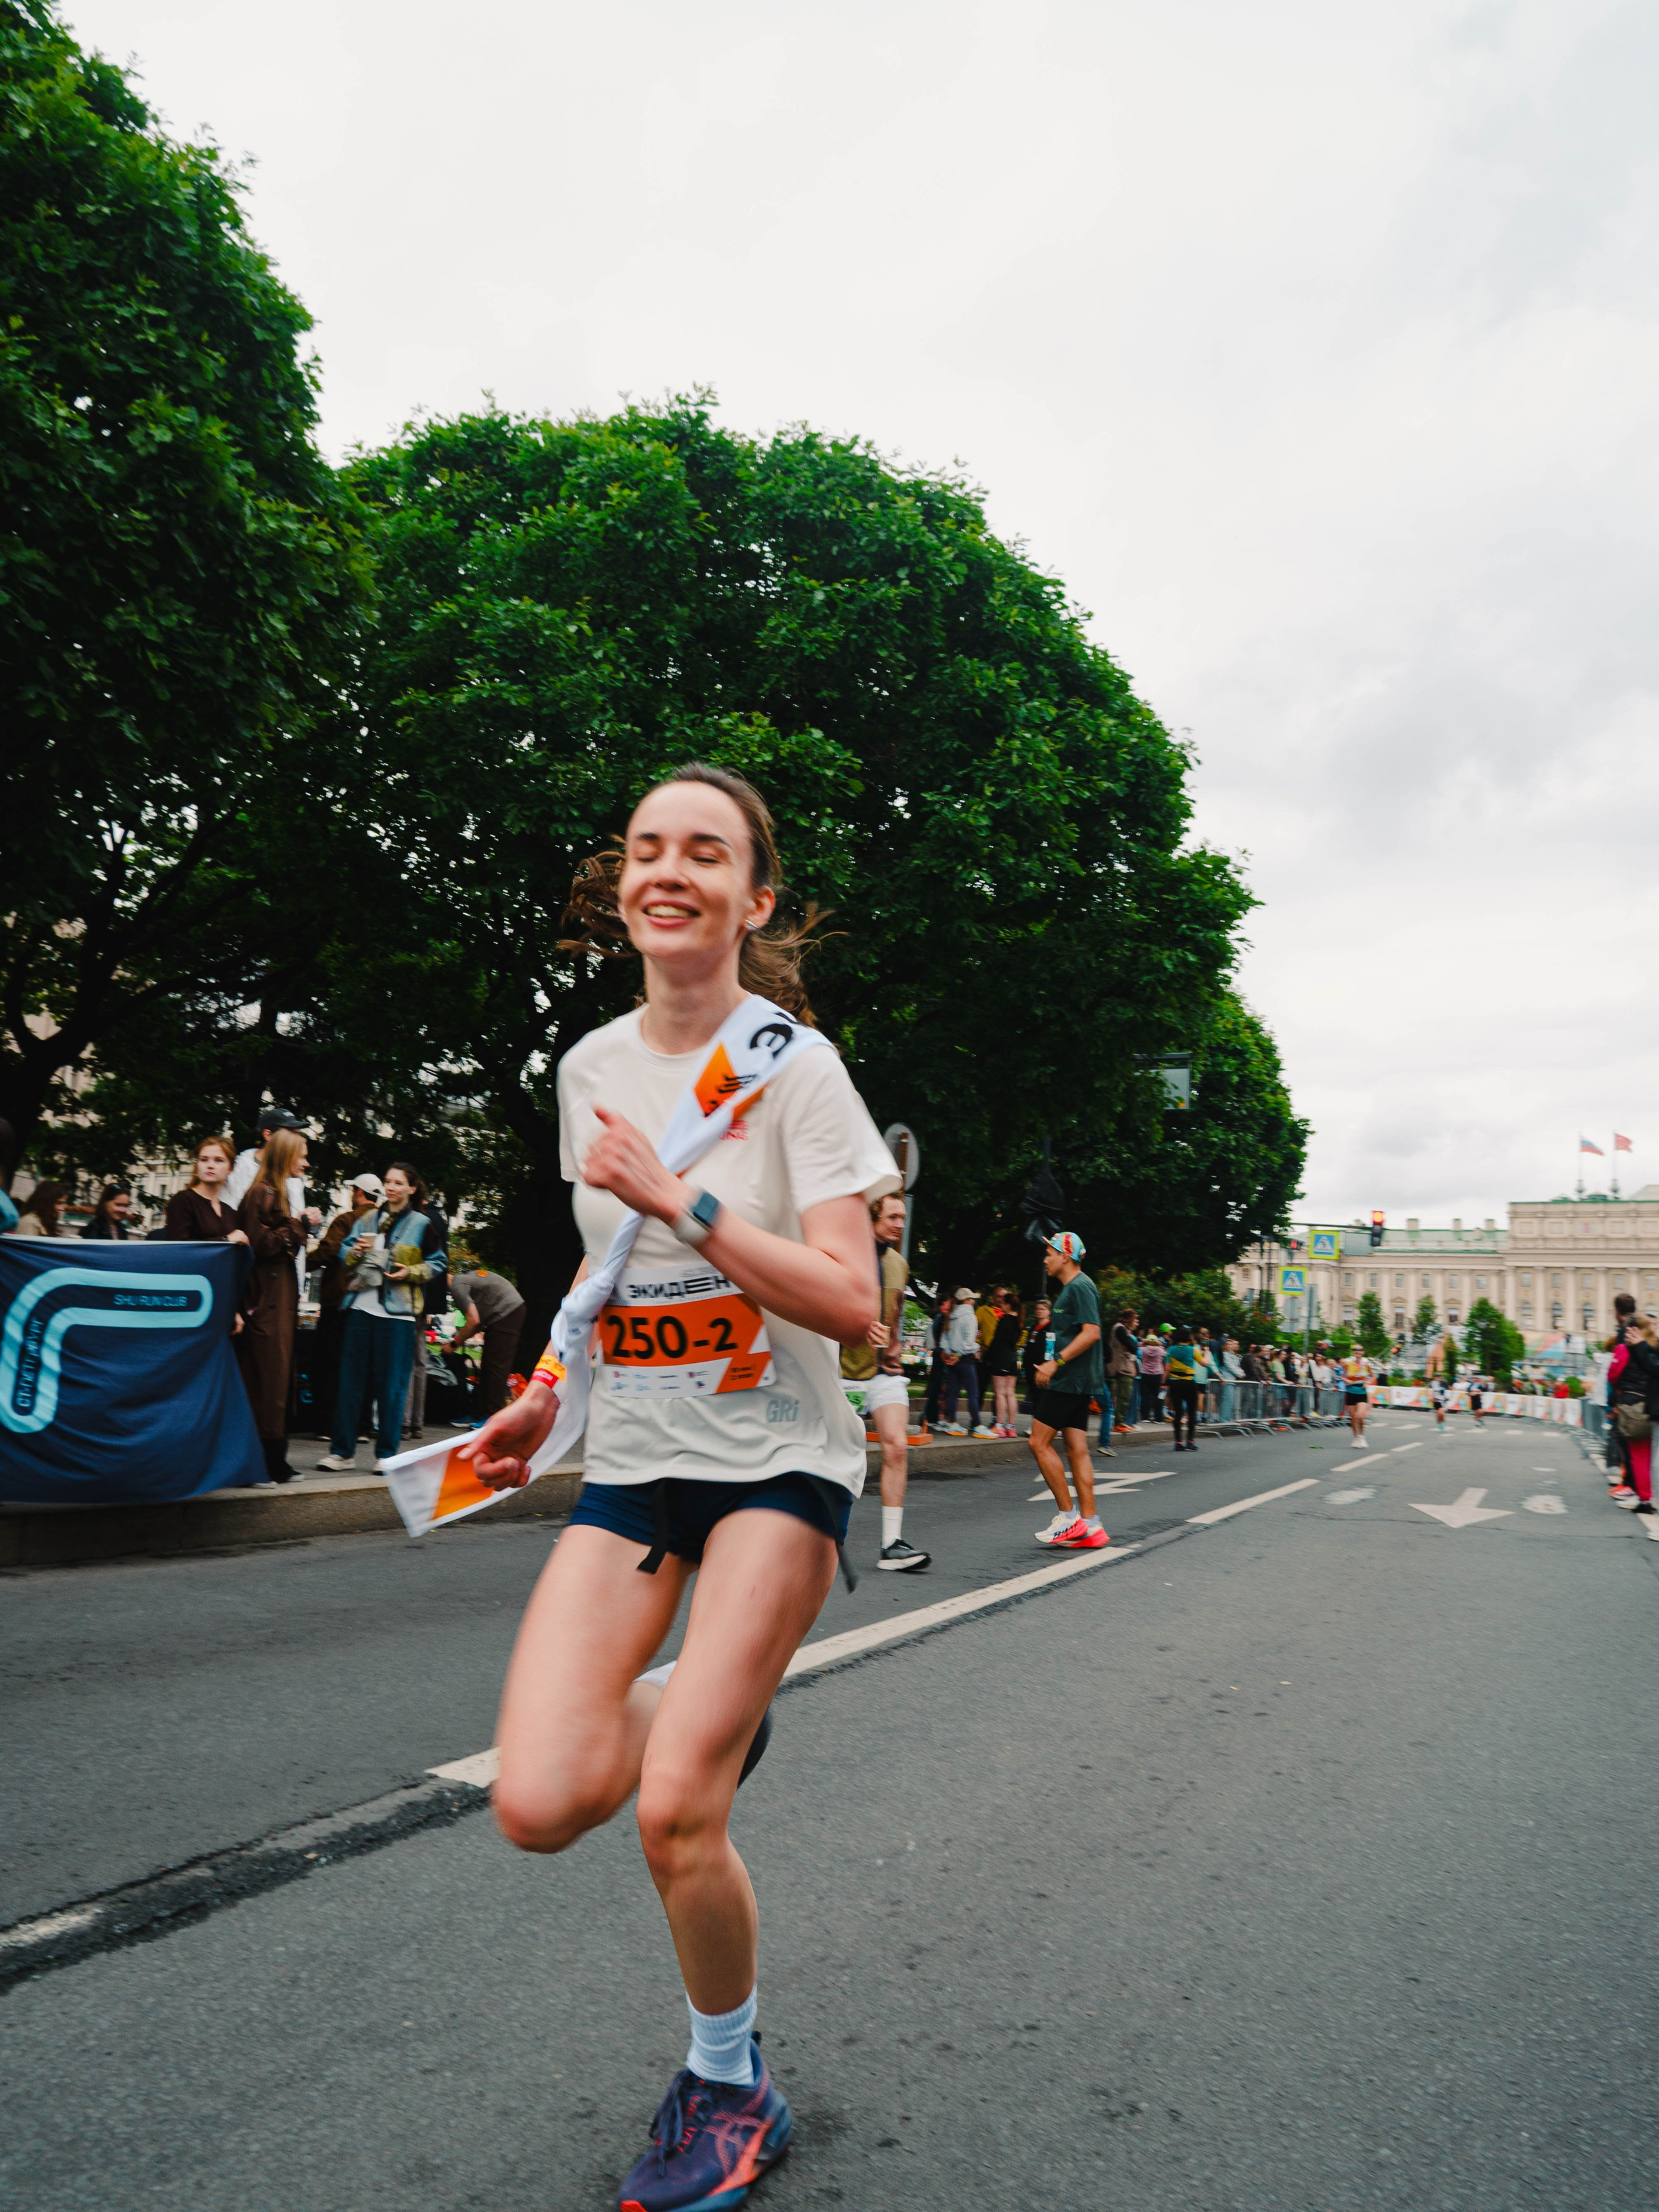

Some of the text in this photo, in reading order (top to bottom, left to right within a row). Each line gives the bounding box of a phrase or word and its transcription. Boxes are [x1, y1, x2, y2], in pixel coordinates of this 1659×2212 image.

[627, 1275, 731, 1299] ЭКИДЕН
[139, 1295, 163, 1307] RUN
[163, 1296, 187, 1307] CLUB
[605, 1315, 739, 1359] 250-2
